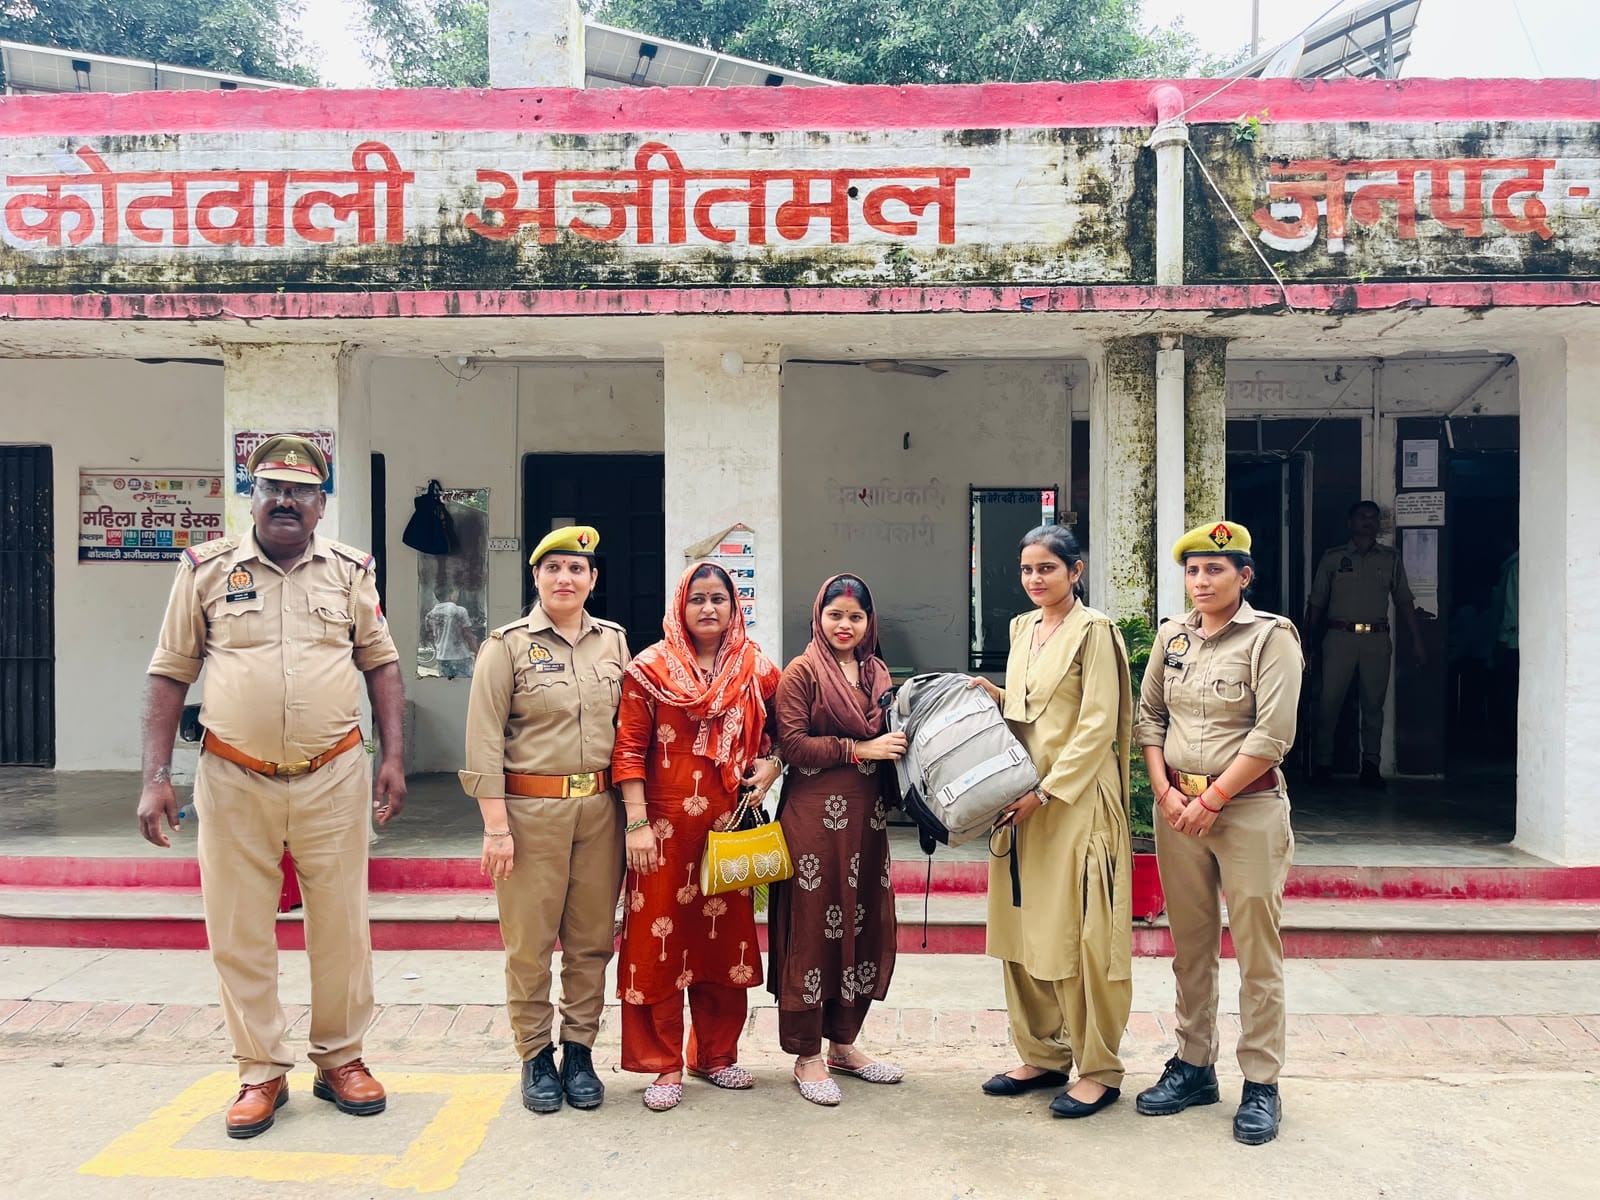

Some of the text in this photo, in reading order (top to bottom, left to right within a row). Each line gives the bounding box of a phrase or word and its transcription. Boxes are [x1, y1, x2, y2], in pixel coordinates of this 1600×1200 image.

[4, 141, 414, 246] कोतवाली
[463, 141, 970, 246] अजीतमल
[83, 505, 221, 528] महिला हेल्प डेस्क
